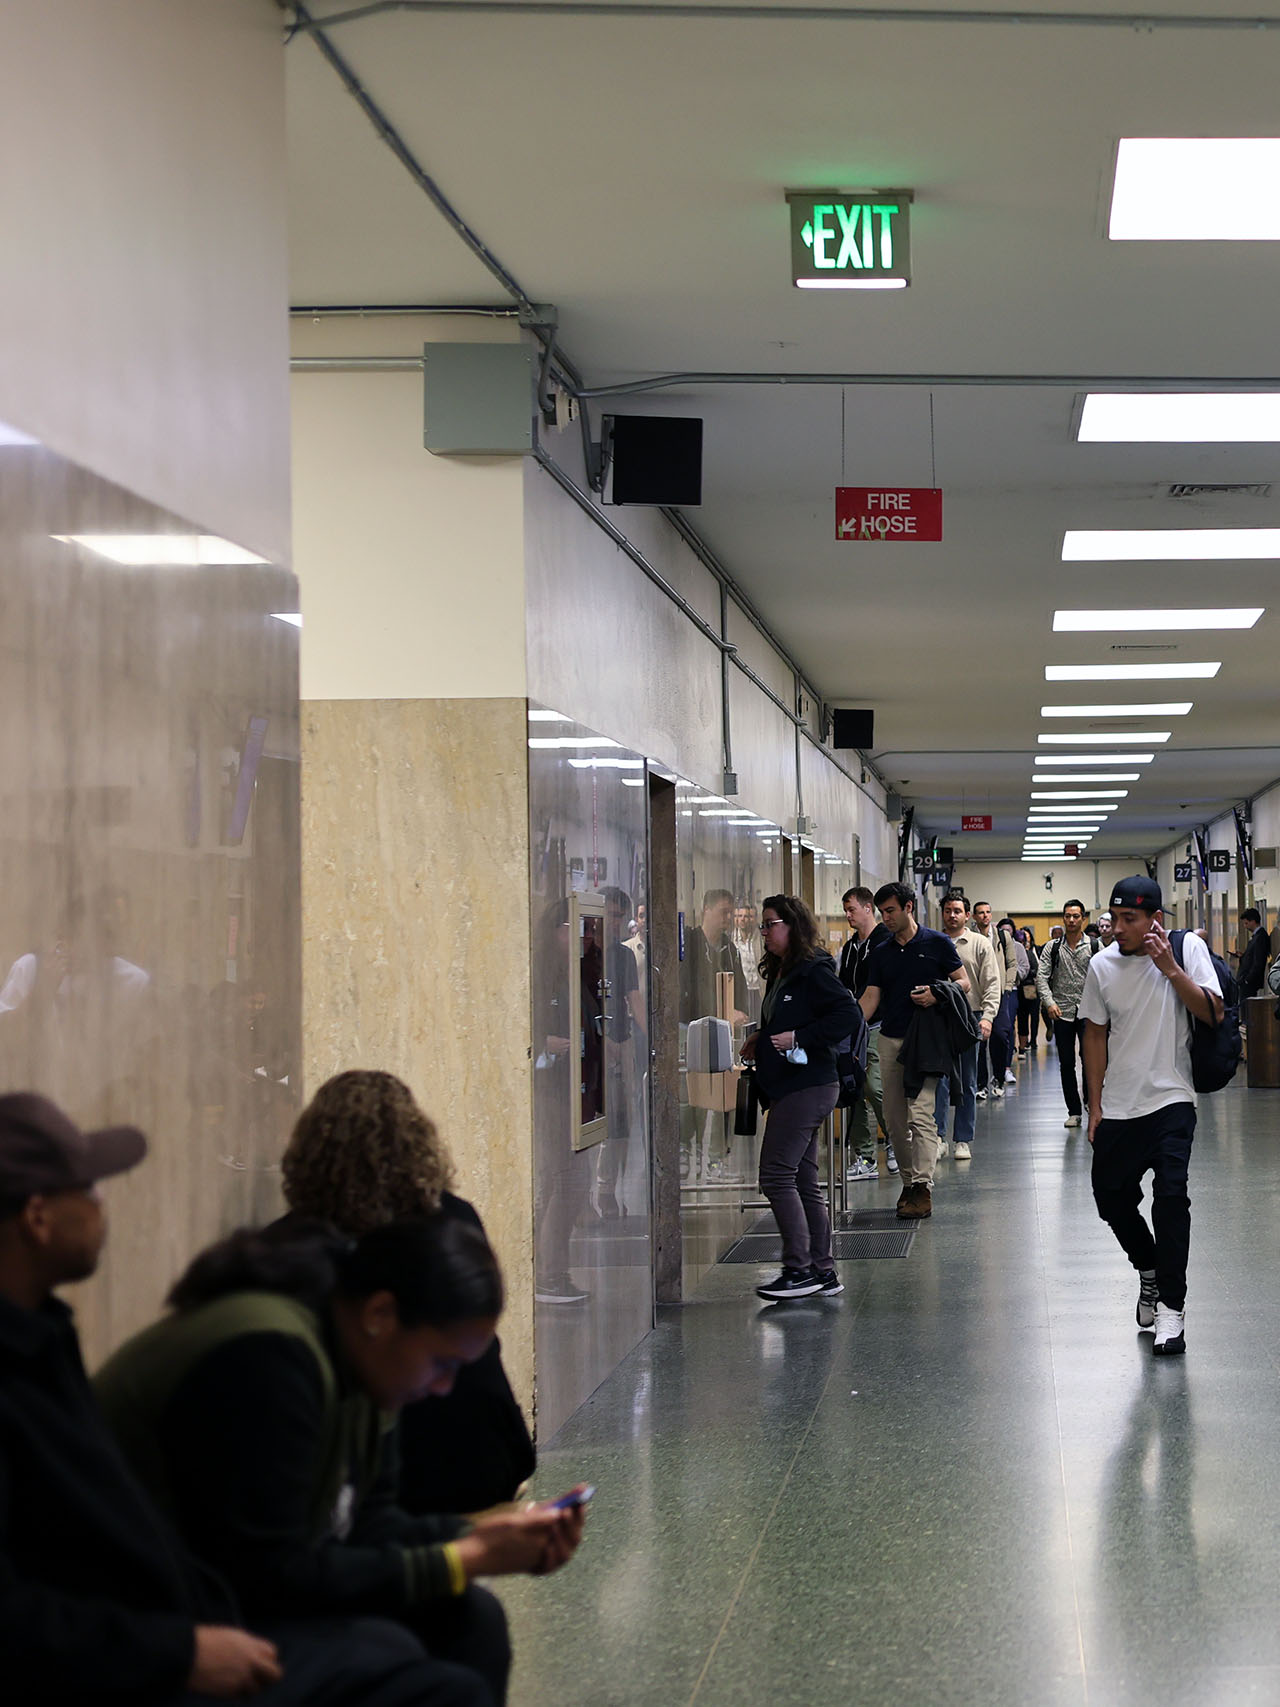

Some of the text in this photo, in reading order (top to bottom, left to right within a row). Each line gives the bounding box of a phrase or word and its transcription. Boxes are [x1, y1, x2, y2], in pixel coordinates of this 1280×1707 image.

[813, 204, 899, 269] EXIT
[867, 493, 911, 510] FIRE
[861, 516, 917, 534] HOSE
[915, 856, 934, 869] 29
[1213, 855, 1226, 867] 15
[936, 872, 947, 882] 14
[1176, 868, 1190, 878] 27
